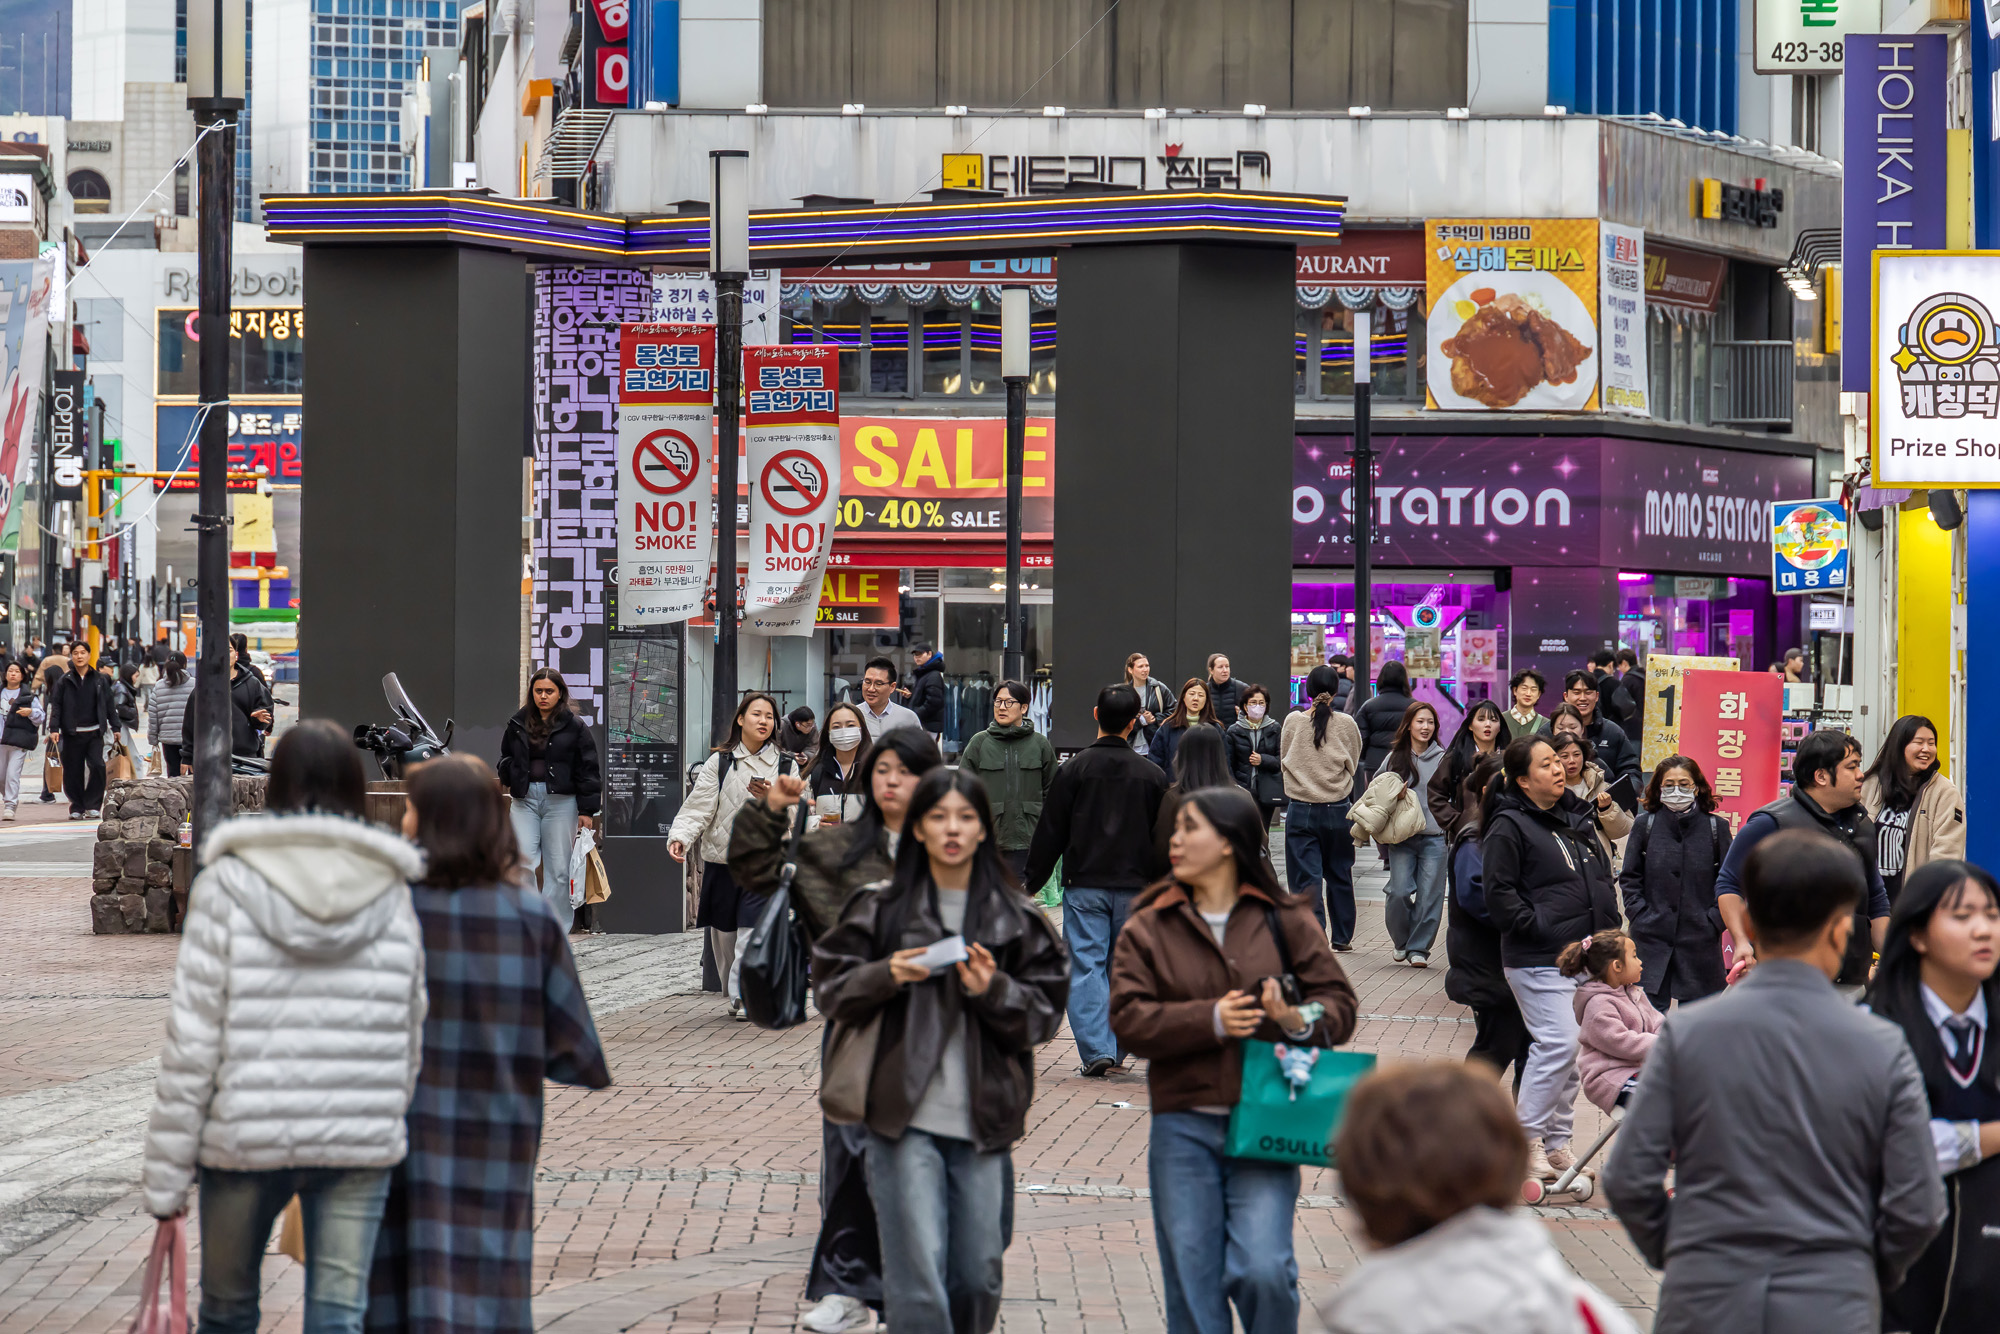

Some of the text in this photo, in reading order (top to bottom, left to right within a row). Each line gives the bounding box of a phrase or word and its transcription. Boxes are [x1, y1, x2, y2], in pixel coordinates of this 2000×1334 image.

[1877, 42, 1915, 204] HOLIKA
[1436, 225, 1531, 241] 추억의 1980
[1453, 246, 1585, 272] 심해돈까스
[668, 288, 692, 304] 경기
[697, 288, 710, 304] 속
[701, 308, 714, 322] 수
[635, 343, 700, 367] 동성로
[625, 368, 710, 392] 금연거리
[759, 366, 825, 389] 동성로
[749, 389, 835, 414] 금연거리
[1901, 383, 2000, 419] 캐칭덕
[627, 414, 640, 422] CGV
[852, 425, 1047, 489] SALE
[1891, 438, 2000, 458] Prize Sho
[635, 501, 697, 532] NO!
[950, 511, 1001, 528] SALE
[635, 534, 697, 550] SMOKE
[765, 522, 826, 554] NO!
[638, 564, 694, 575] 흡연시 5만원의
[765, 555, 820, 572] SMOKE
[628, 576, 702, 586] 과태료가 부과됩니다
[1781, 568, 1845, 587] 미용실
[766, 585, 791, 595] 흡연시
[647, 605, 681, 614] 대구광역시
[836, 612, 859, 621] SALE
[1656, 733, 1678, 744] 24K
[1715, 691, 1749, 797] 화장품
